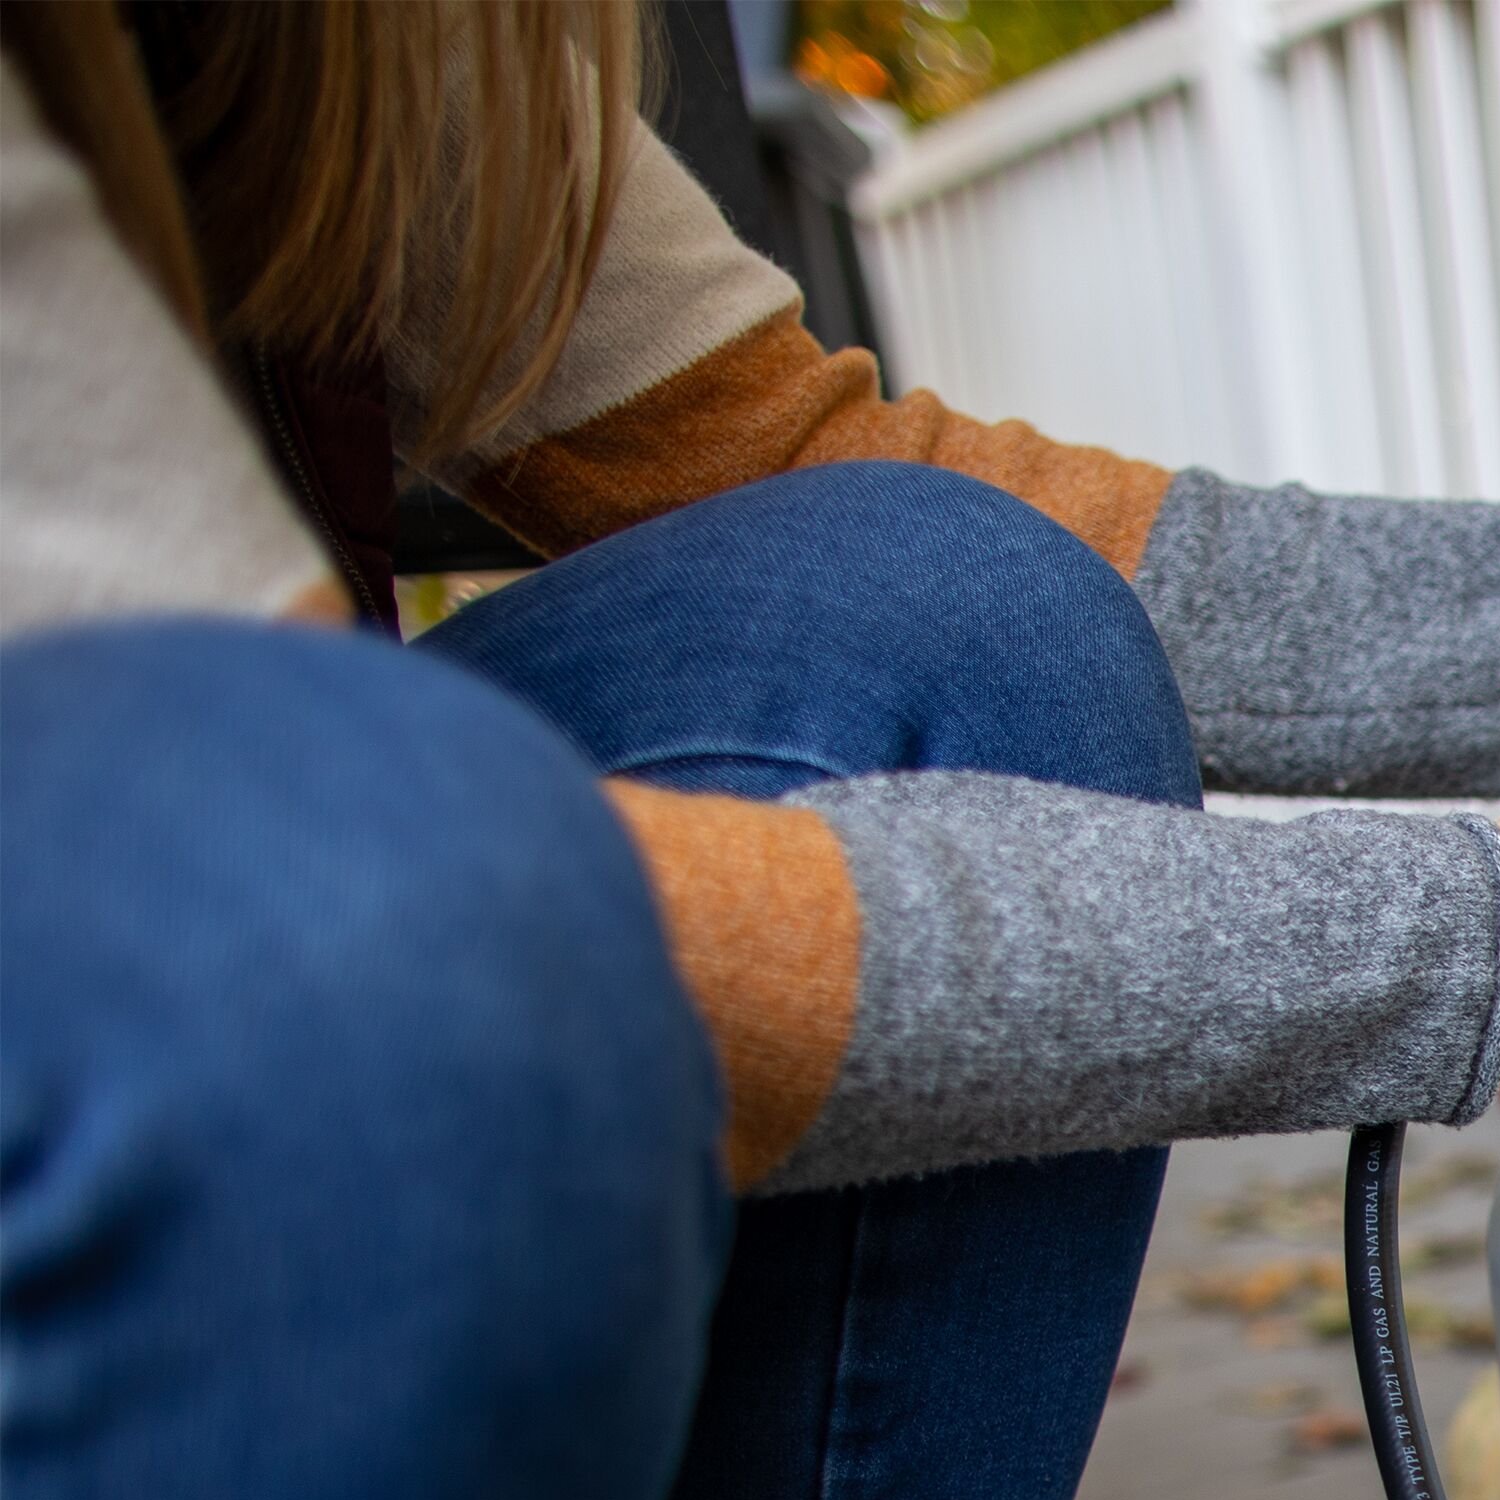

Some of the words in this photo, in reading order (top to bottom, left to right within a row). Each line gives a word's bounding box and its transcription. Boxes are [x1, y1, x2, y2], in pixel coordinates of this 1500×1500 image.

[1366, 1139, 1382, 1172] GAS
[1364, 1181, 1380, 1257] NATURAL
[1368, 1266, 1385, 1300] AND
[1374, 1307, 1391, 1339] GAS
[1380, 1345, 1395, 1364] LP
[1385, 1373, 1404, 1407] UL21
[1394, 1414, 1411, 1439] T/P
[1403, 1445, 1425, 1485] TYPE
